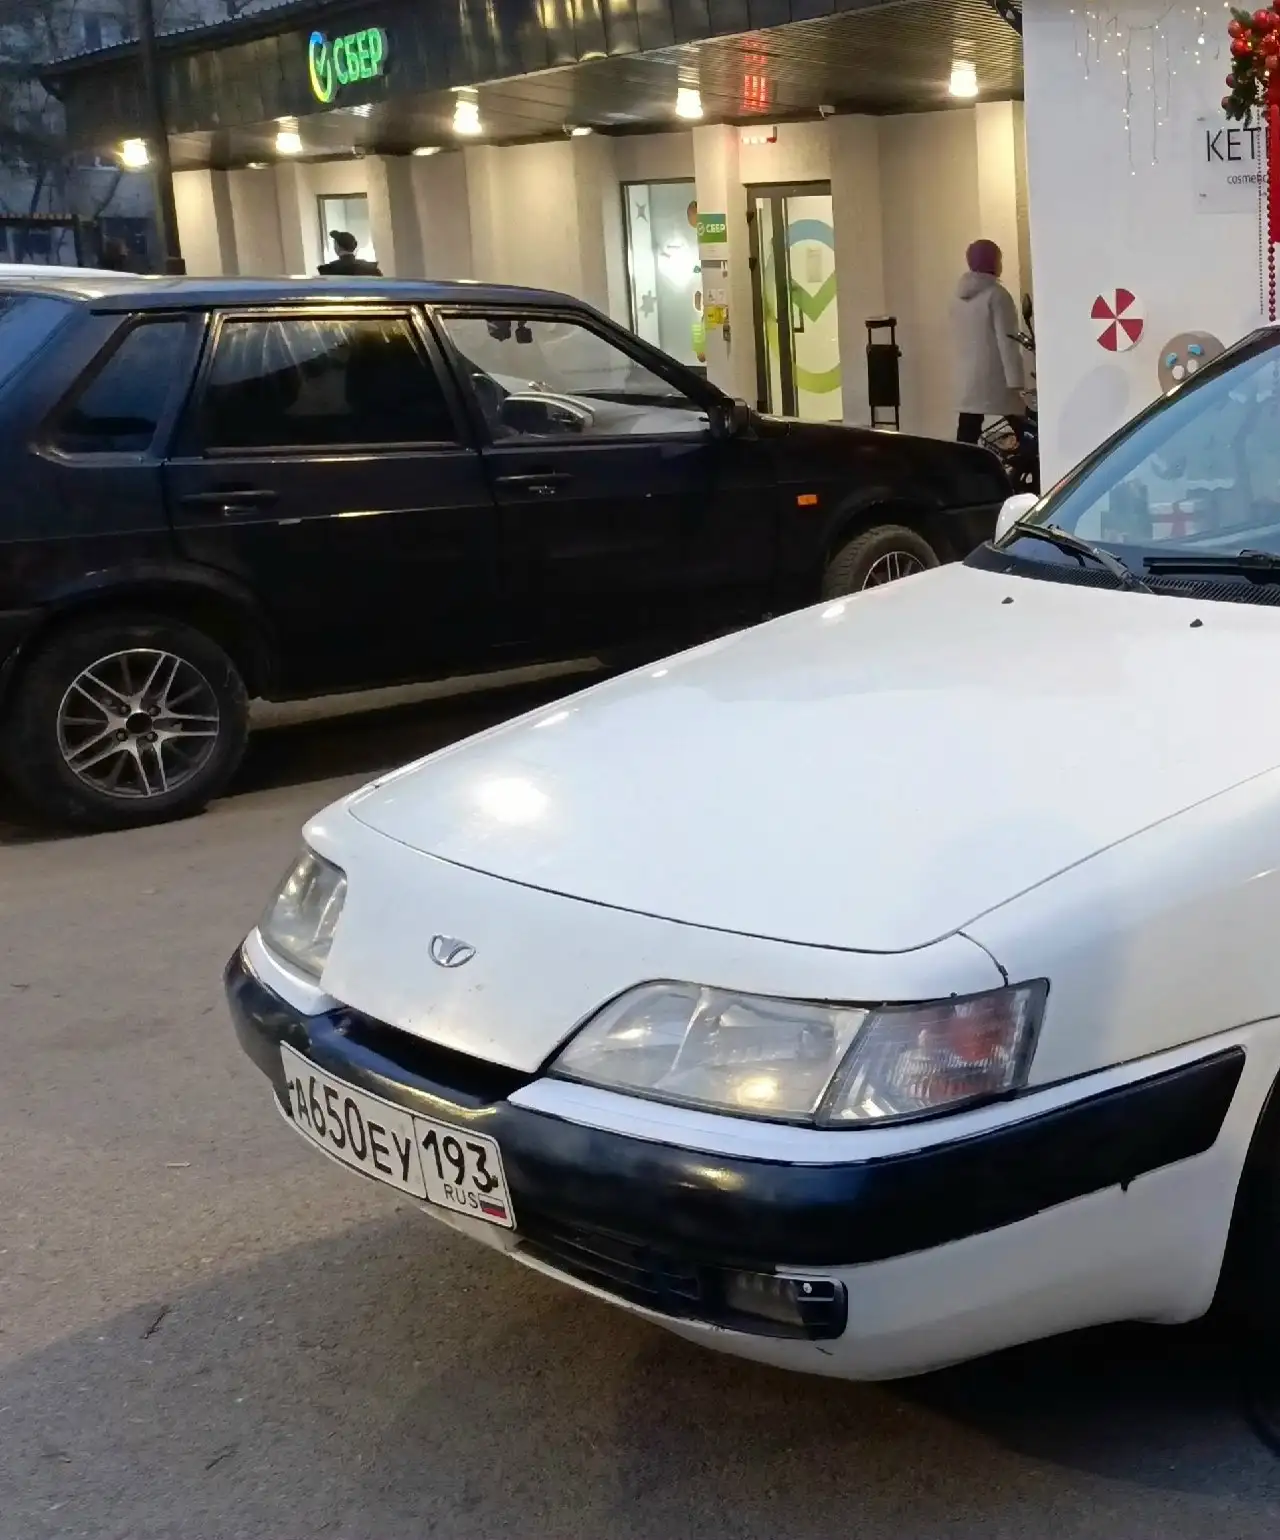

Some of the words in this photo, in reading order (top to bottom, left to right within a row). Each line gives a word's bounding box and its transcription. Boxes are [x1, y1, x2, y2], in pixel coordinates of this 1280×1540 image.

[333, 27, 384, 84] СБЕР
[422, 1129, 493, 1194] 193
[443, 1183, 480, 1210] RUS
